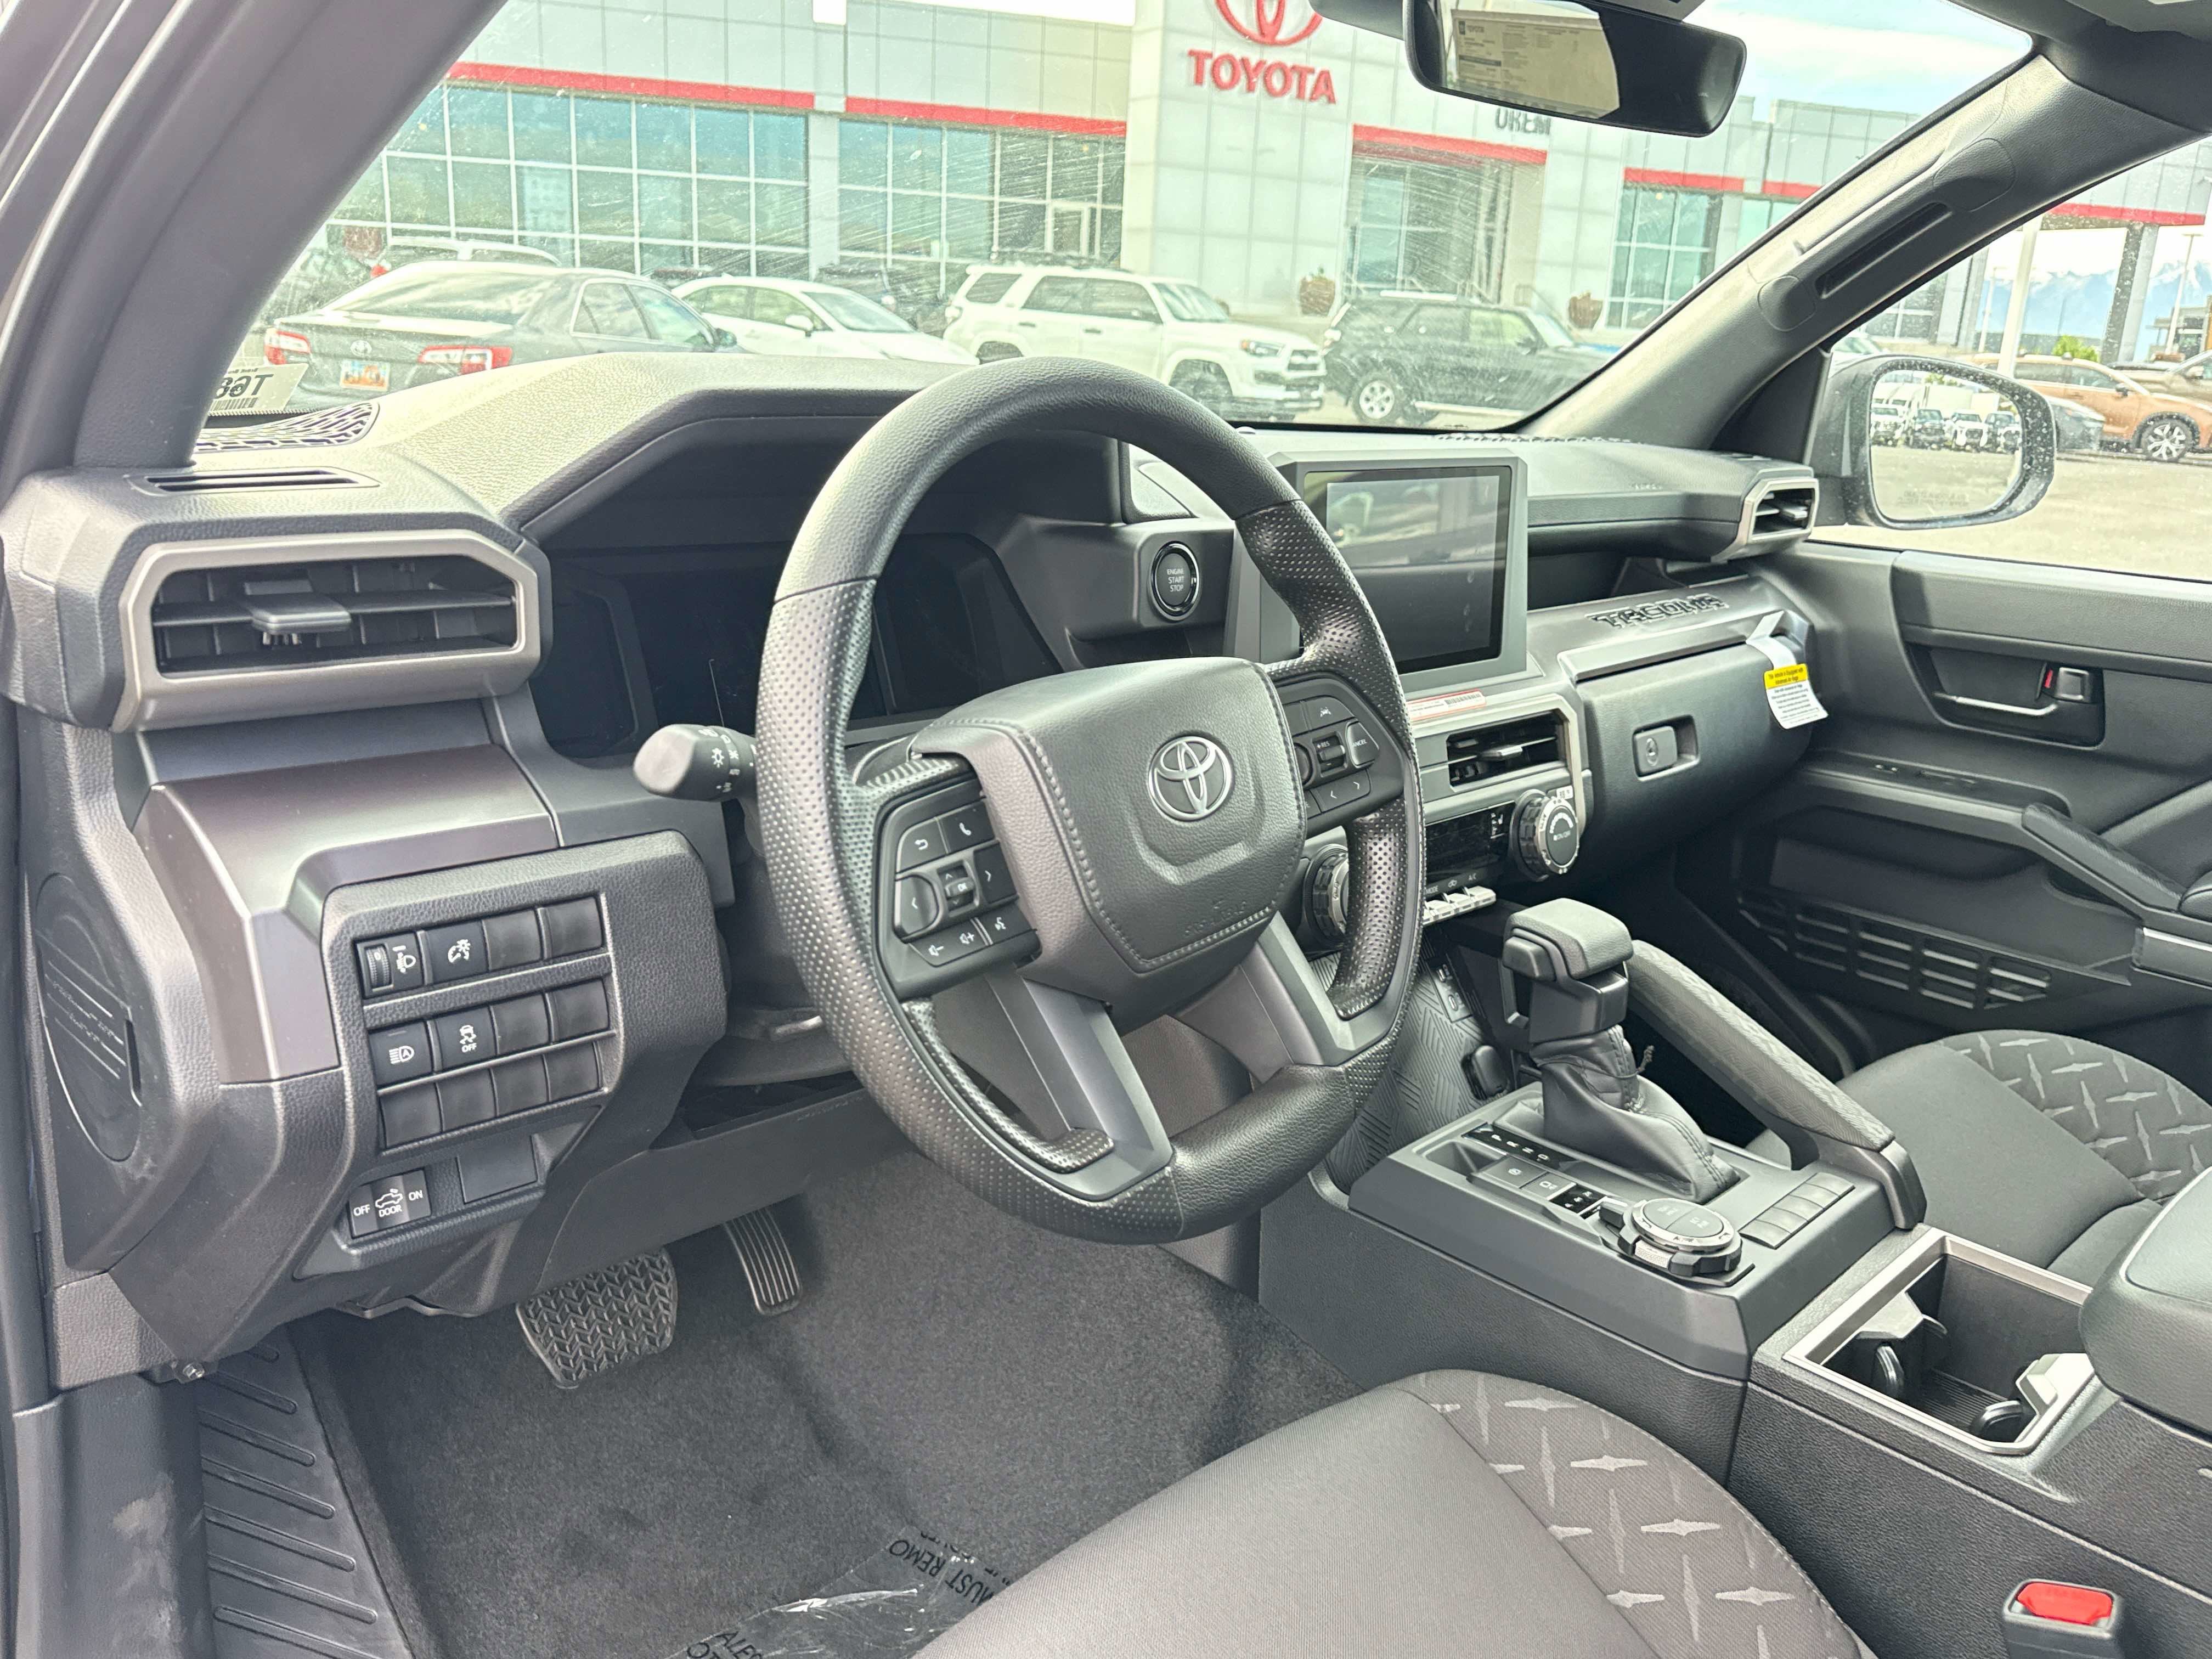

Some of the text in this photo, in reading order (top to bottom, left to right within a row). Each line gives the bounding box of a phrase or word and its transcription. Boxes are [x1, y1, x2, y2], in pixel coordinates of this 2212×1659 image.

[1188, 49, 1336, 104] TOYOTA
[1585, 593, 1729, 628] TACOMA
[461, 1042, 477, 1053] OFF
[408, 1189, 424, 1201] ON
[353, 1204, 370, 1216] OFF
[379, 1204, 402, 1217] DOOR
[889, 1539, 945, 1575] REMO
